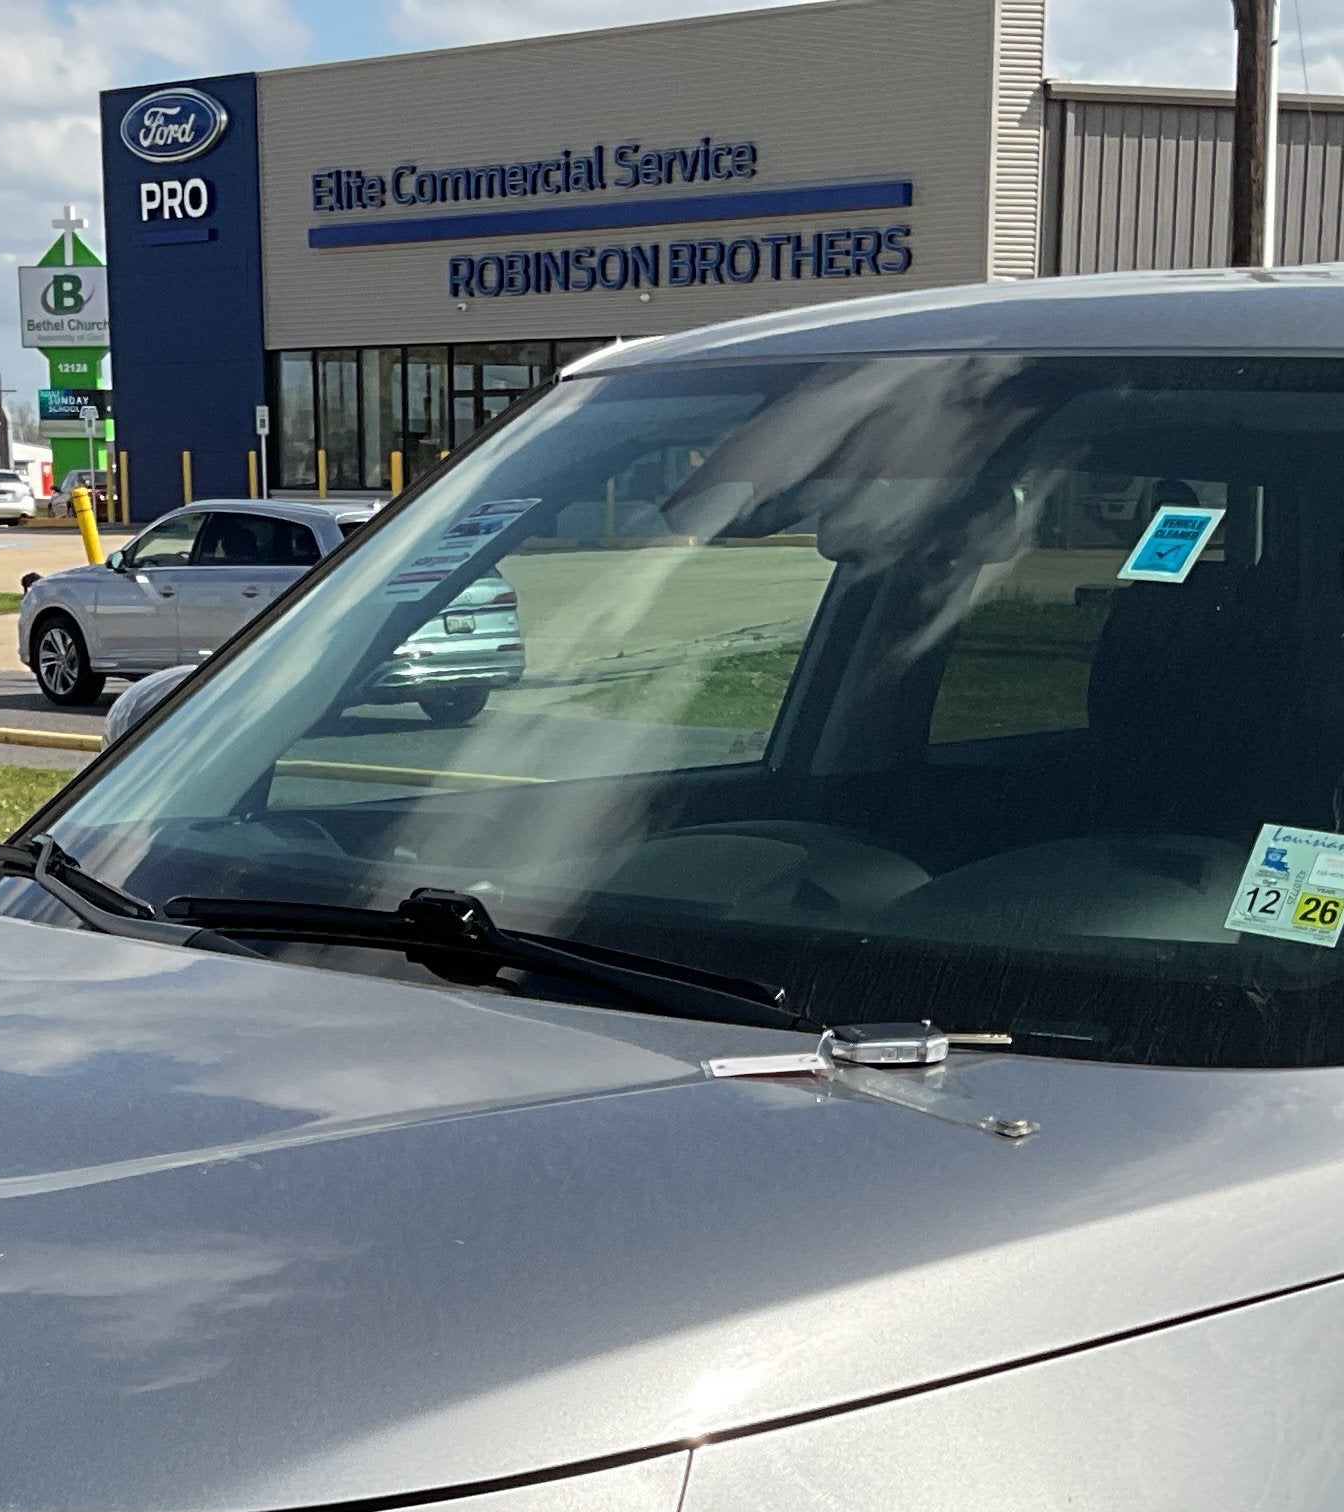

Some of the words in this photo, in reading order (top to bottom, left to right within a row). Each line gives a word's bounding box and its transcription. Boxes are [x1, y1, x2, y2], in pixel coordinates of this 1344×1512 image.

[139, 106, 196, 148] Ford
[311, 169, 386, 212] Elite
[391, 145, 607, 206] Commercial
[614, 137, 757, 188] Service
[140, 177, 208, 222] PRO
[448, 243, 659, 299] ROBINSON
[668, 226, 912, 287] BROTHERS
[53, 274, 84, 312] B
[27, 319, 64, 331] Bethel
[48, 396, 89, 405] SUNDAY
[1246, 887, 1281, 915] 12
[1299, 897, 1340, 925] 26
